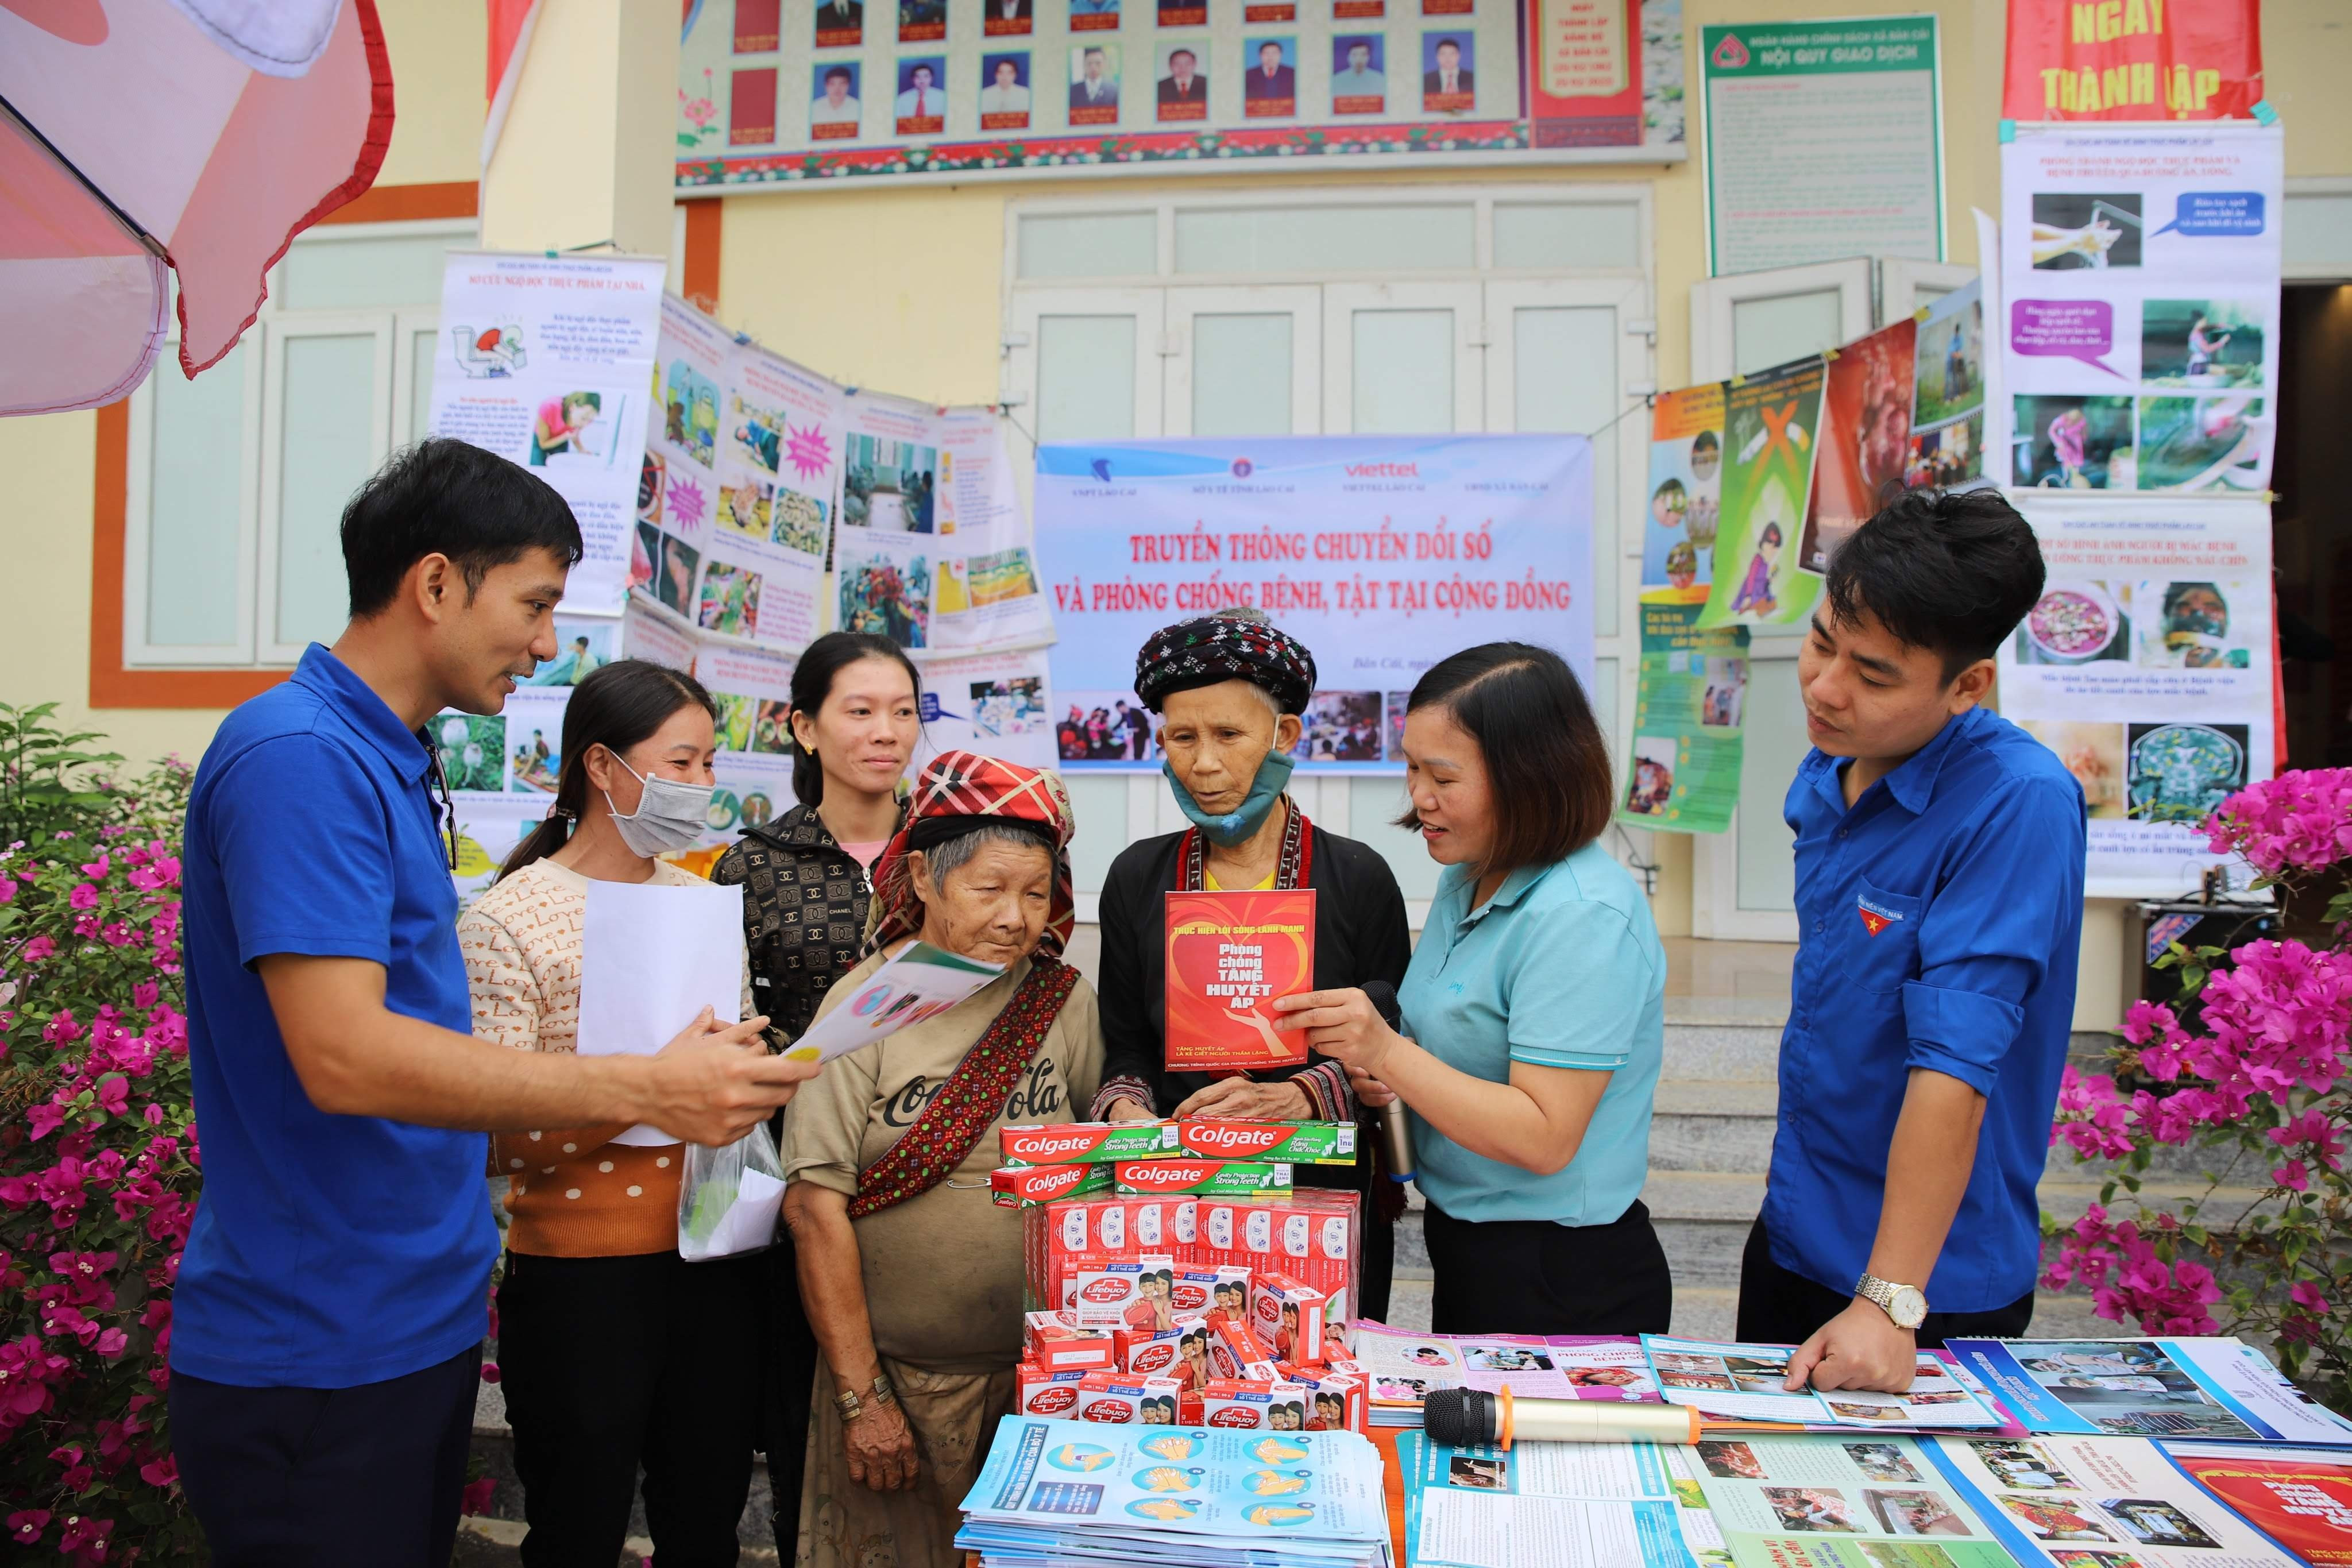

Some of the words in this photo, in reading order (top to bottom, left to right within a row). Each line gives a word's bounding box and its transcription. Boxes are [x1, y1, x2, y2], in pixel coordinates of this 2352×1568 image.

[1760, 47, 1791, 68] NỘI
[1793, 48, 1828, 64] QUY
[1830, 46, 1874, 63] GIAO
[1876, 44, 1917, 64] DỊCH
[2040, 62, 2155, 112] THÀNH
[1345, 462, 1419, 477] viettel
[1228, 525, 1307, 561] THÔNG
[1314, 515, 1409, 561] CHUYỂN
[1415, 515, 1457, 560] ĐỔI
[1463, 518, 1493, 559] SỐ
[1054, 576, 1086, 612] VÀ
[1092, 575, 1168, 611] PHÒNG
[1176, 569, 1254, 610] CHỐNG
[1261, 573, 1328, 619] BỆNH,
[1335, 573, 1381, 618] TẬT
[1388, 581, 1428, 618] TẠI
[1435, 572, 1498, 619] CỘNG
[1505, 566, 1571, 611] ĐỒNG
[1173, 927, 1195, 936] THỰC
[1233, 924, 1255, 934] SỐNG
[1219, 944, 1262, 956] Phòng
[1219, 955, 1262, 968] chống
[1218, 968, 1263, 982] TĂNG
[1206, 980, 1273, 997] HUYẾT
[1230, 997, 1254, 1009] ÁP
[1188, 1125, 1274, 1147] Colgate
[1014, 1137, 1091, 1155] Colgate
[1104, 1143, 1129, 1152] Strong
[1025, 1169, 1080, 1193] Colgate
[1090, 1171, 1106, 1180] Strong
[1125, 1167, 1201, 1184] Colgate
[1214, 1177, 1239, 1185] Strong
[1172, 1293, 1203, 1302] ifebuoy
[1259, 1299, 1279, 1317] Lifebuoy
[1136, 1353, 1171, 1364] Lifebuoy
[1215, 1347, 1233, 1378] Lifebuoy
[1033, 1395, 1074, 1405] Lifebuoy
[1088, 1407, 1130, 1418] Lifebuoy
[1214, 1413, 1257, 1424] Lifebuoy
[1025, 1447, 1039, 1456] CỦA
[1022, 1457, 1036, 1471] BƯỚC
